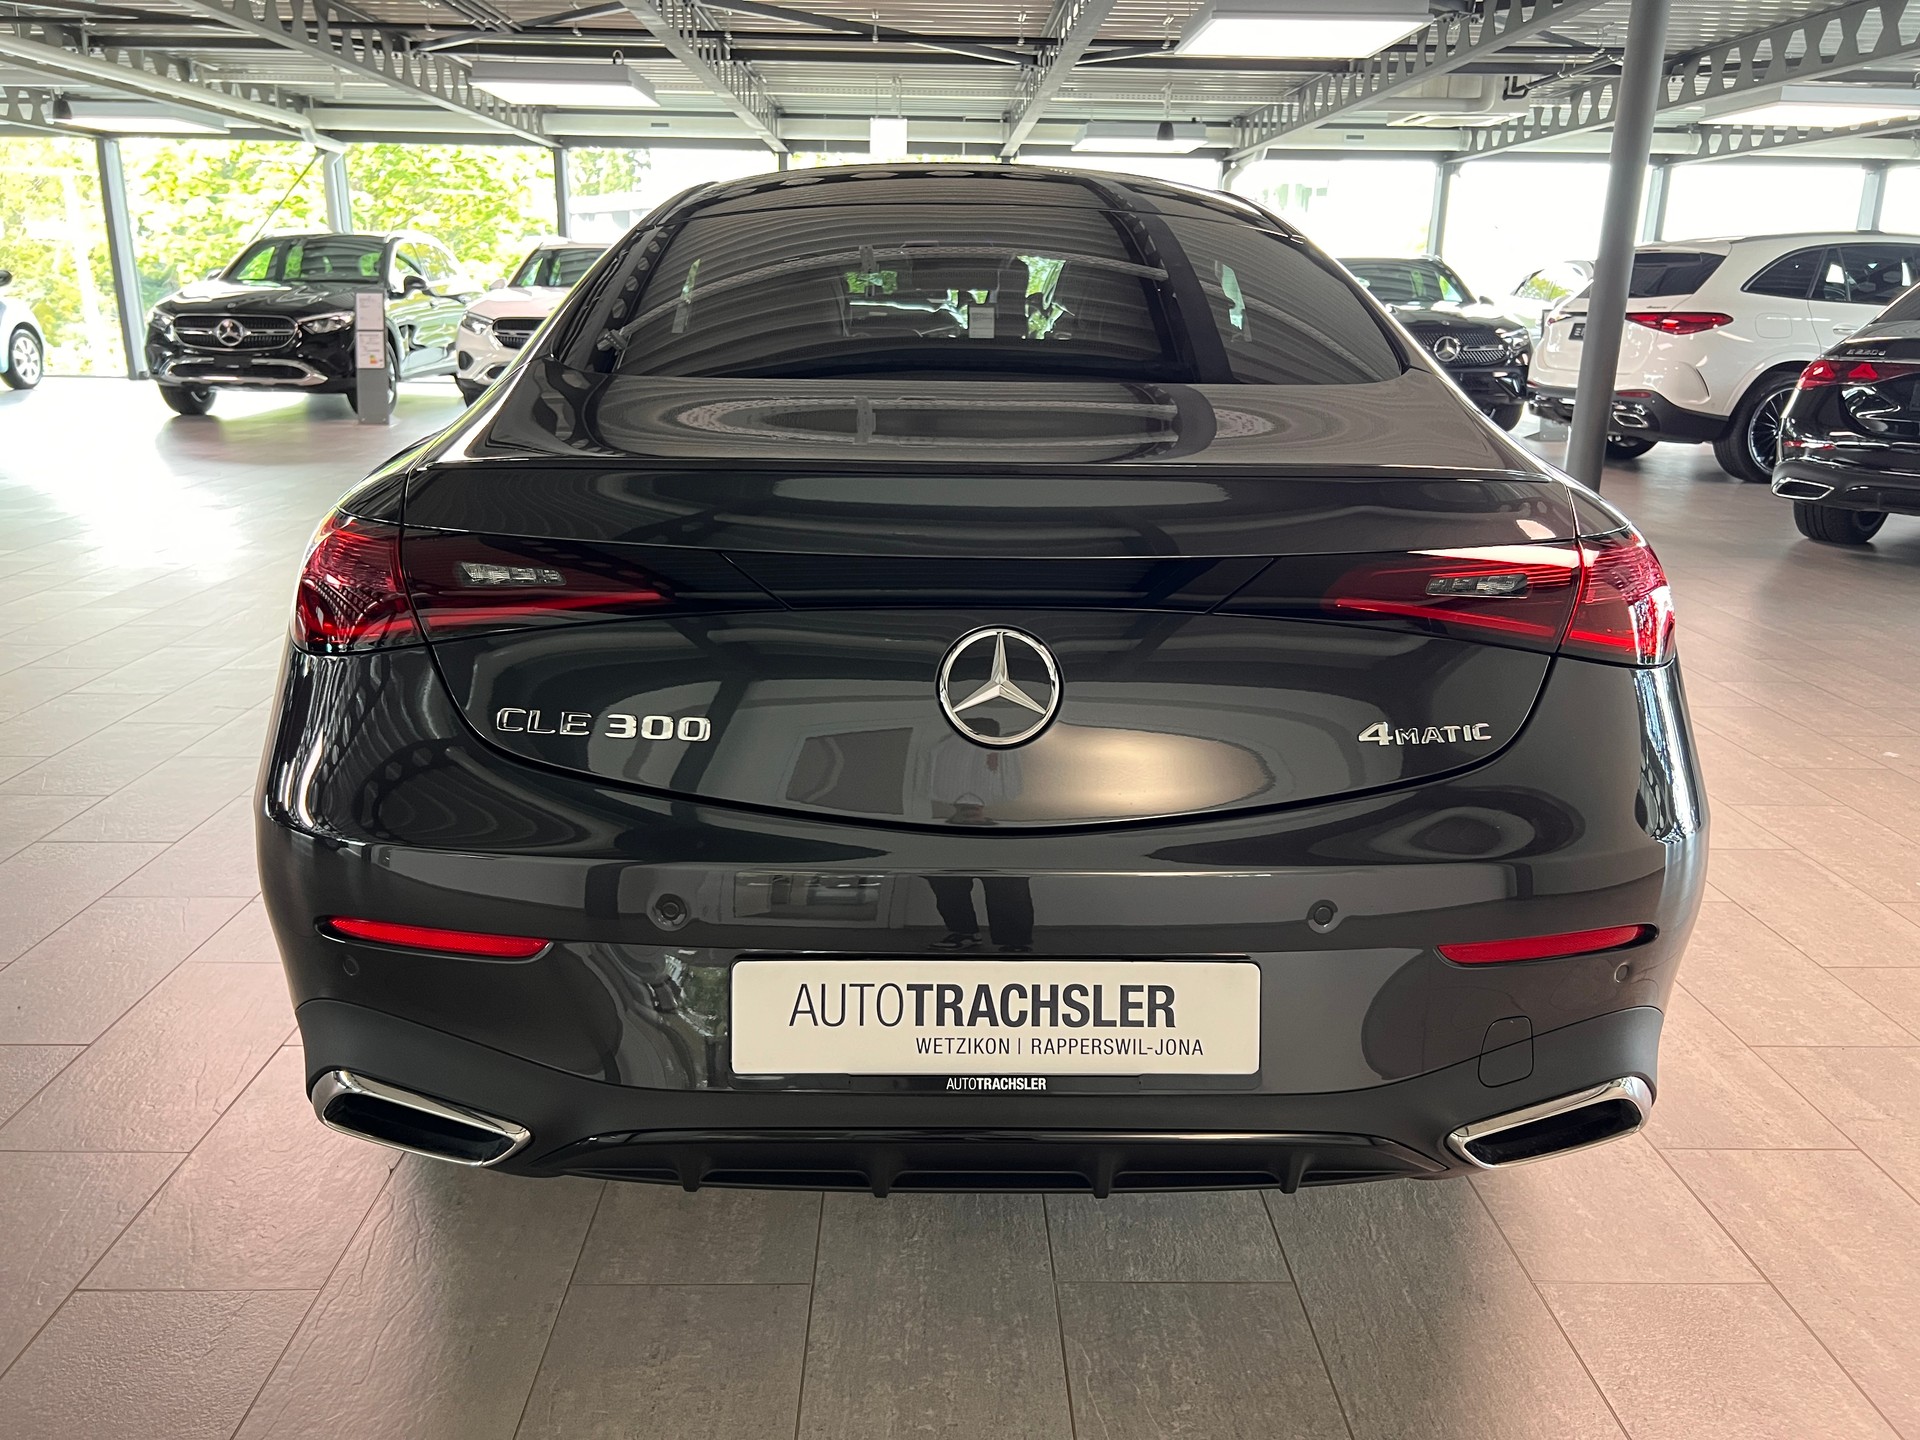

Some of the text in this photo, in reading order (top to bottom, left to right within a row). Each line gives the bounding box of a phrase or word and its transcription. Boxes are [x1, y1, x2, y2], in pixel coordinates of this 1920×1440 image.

[496, 707, 712, 742] CLE 300
[1358, 721, 1492, 746] 4MATIC
[788, 982, 1177, 1028] AUTOTRACHSLER
[915, 1037, 1010, 1055] WETZIKON
[1031, 1037, 1204, 1056] RAPPERSWIL-JONA
[945, 1077, 1047, 1091] AUTOTRACHSLER
